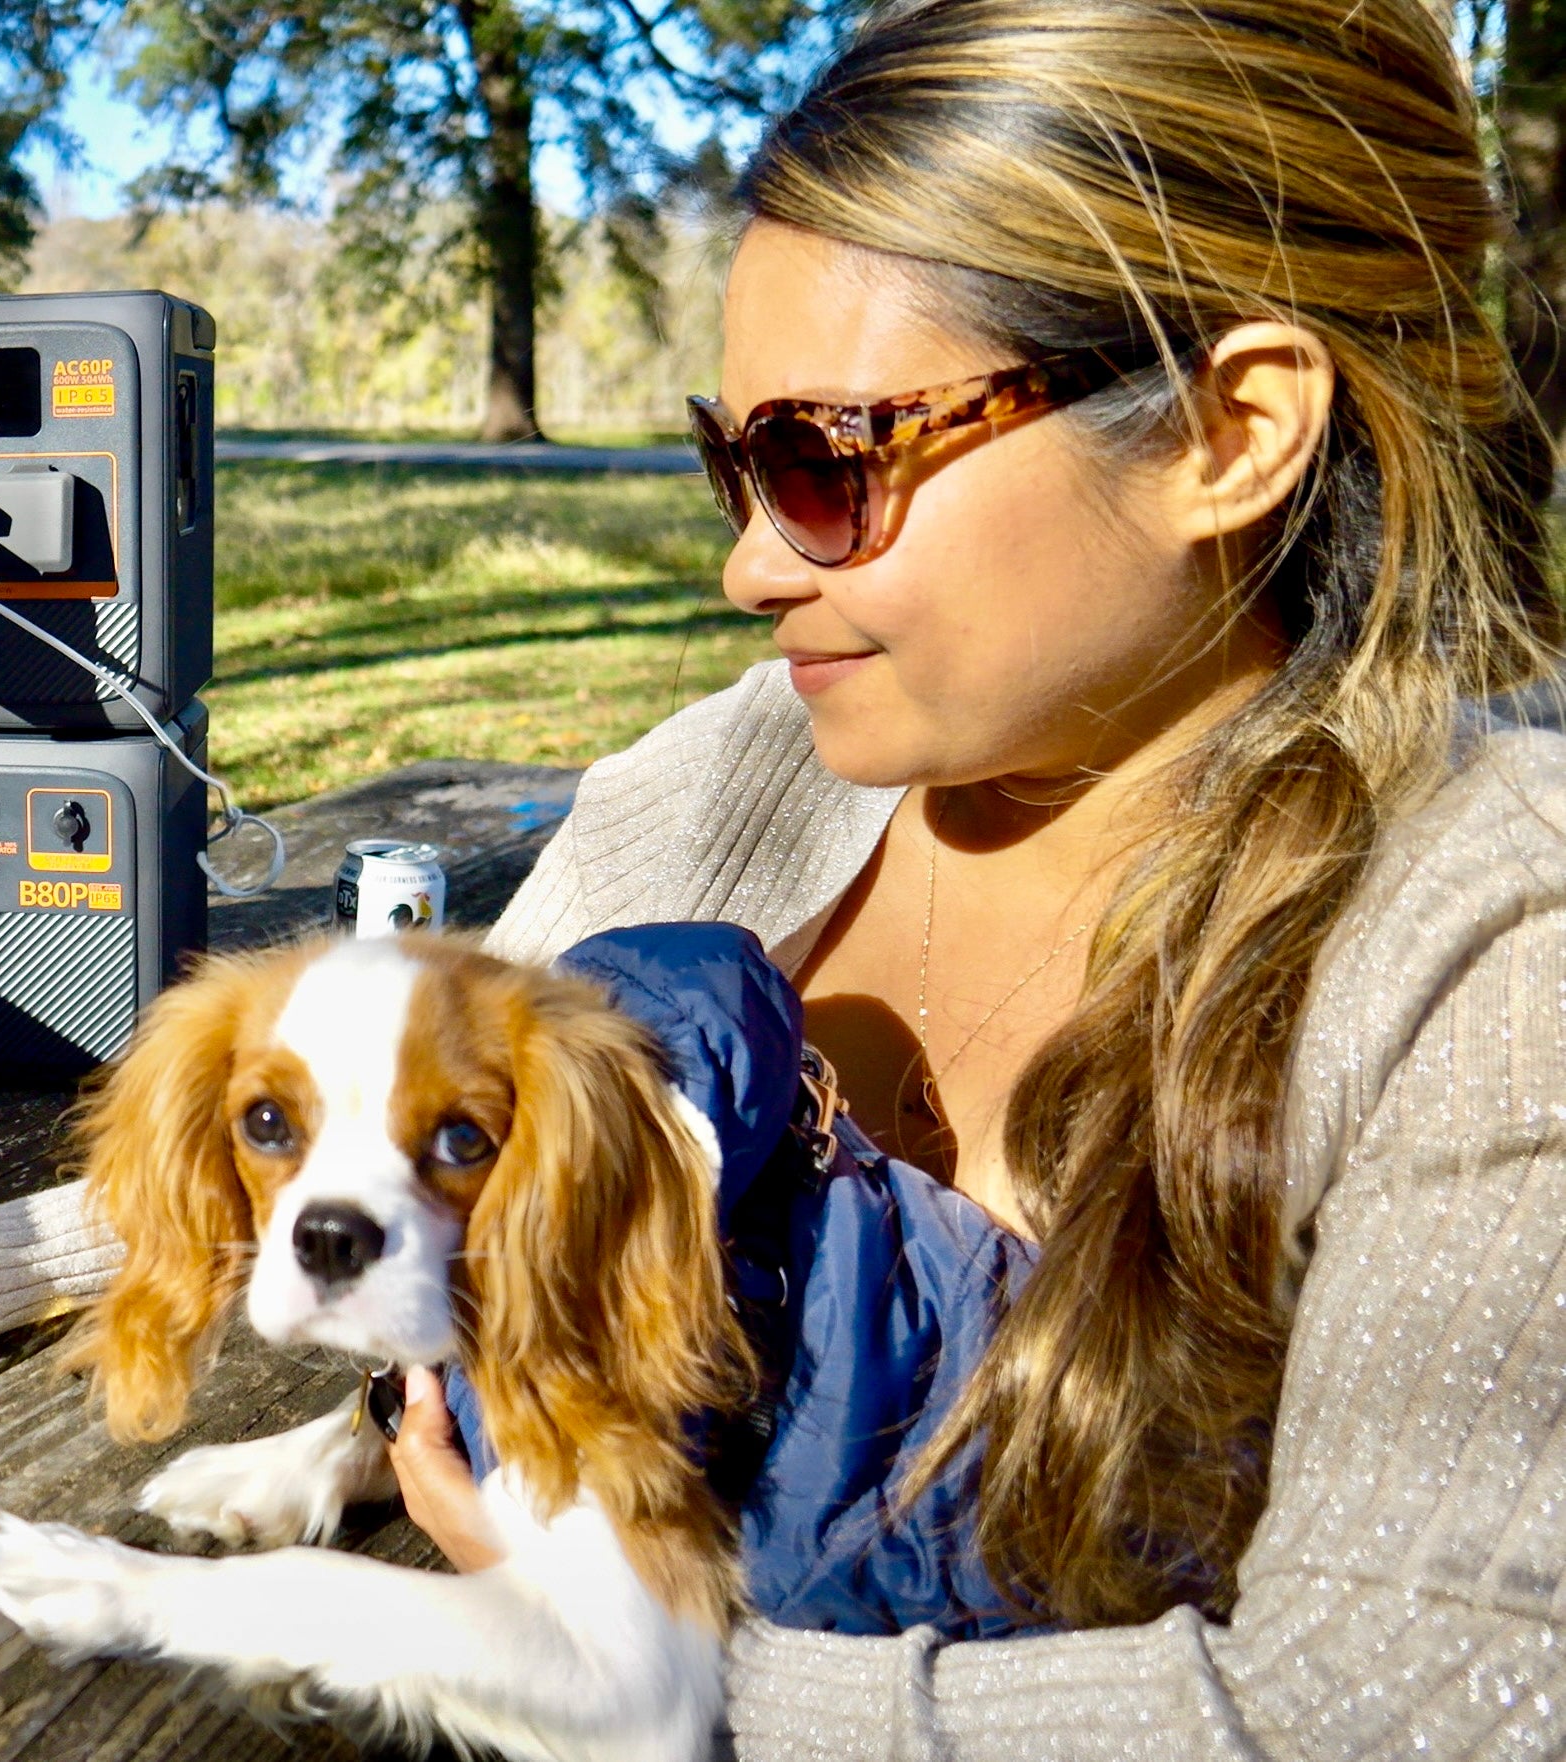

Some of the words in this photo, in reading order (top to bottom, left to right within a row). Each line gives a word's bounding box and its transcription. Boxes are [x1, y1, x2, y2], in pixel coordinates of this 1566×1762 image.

[53, 359, 114, 376] AC60P
[19, 880, 88, 908] B80P
[90, 892, 119, 904] IP65
